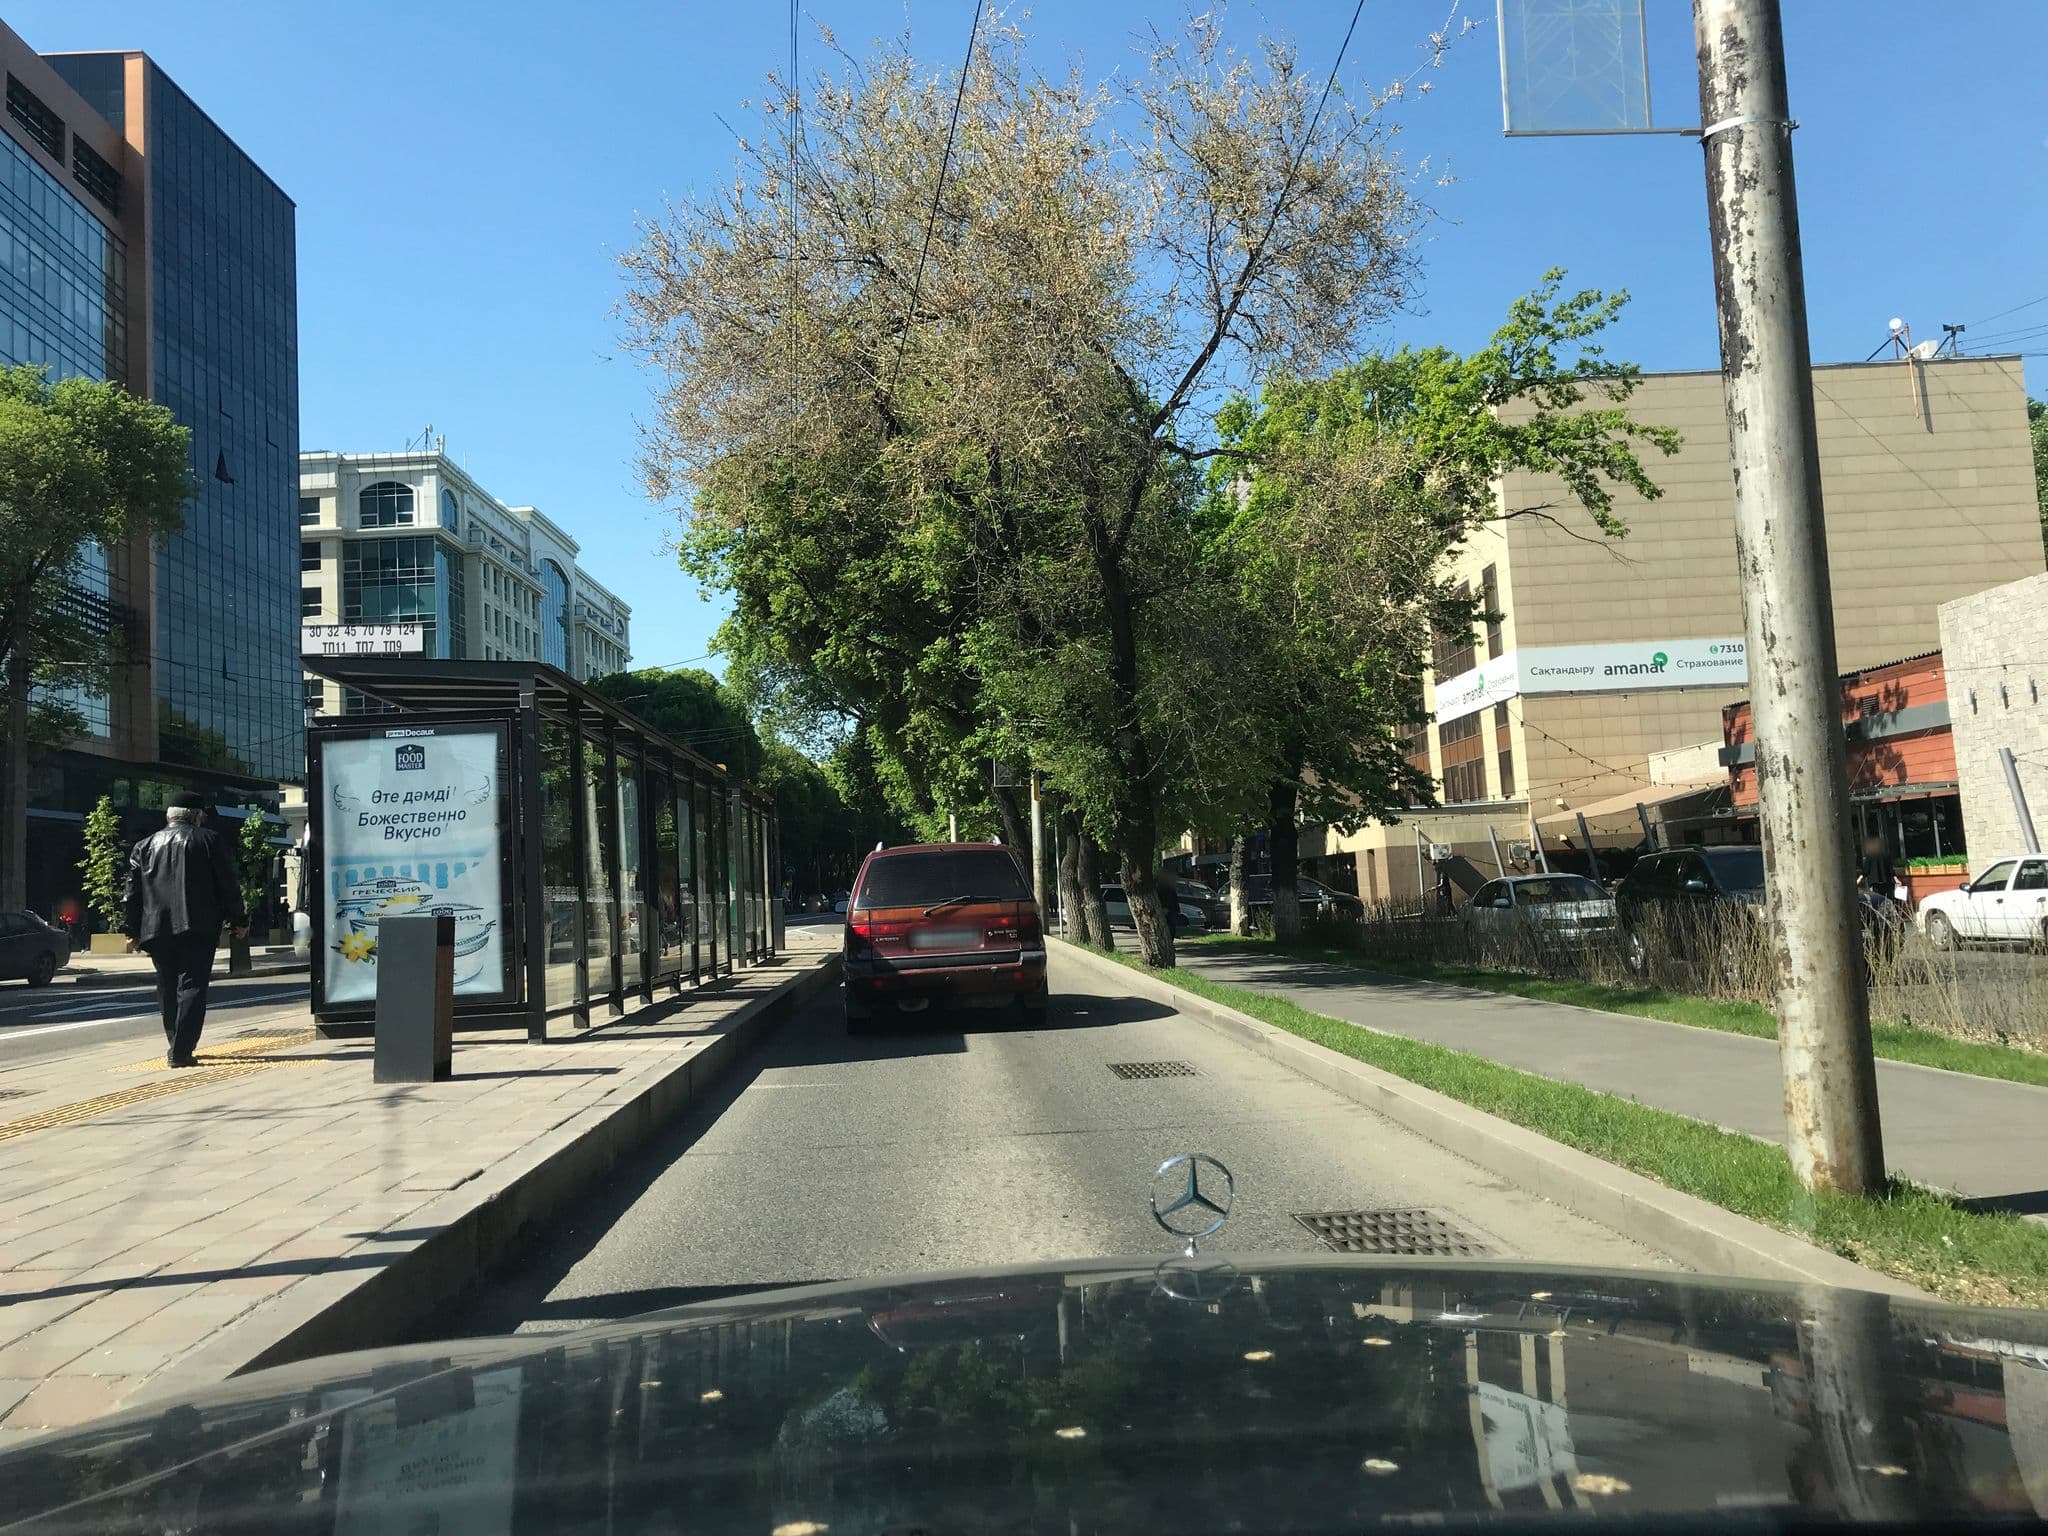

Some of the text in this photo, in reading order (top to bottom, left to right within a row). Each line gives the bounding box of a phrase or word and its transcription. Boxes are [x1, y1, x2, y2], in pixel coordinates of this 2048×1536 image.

[309, 624, 415, 637] 30 32 45 70 79 124
[322, 640, 402, 653] ТП11 ТП7 ТП9
[1719, 644, 1744, 653] 7310
[1530, 657, 1744, 677] Сақтандыру amanat Страхование
[397, 752, 424, 763] FOOD
[371, 789, 400, 804] Өте
[358, 809, 467, 827] Божественно
[352, 886, 421, 896] ГРЕЧЕСКИЙ
